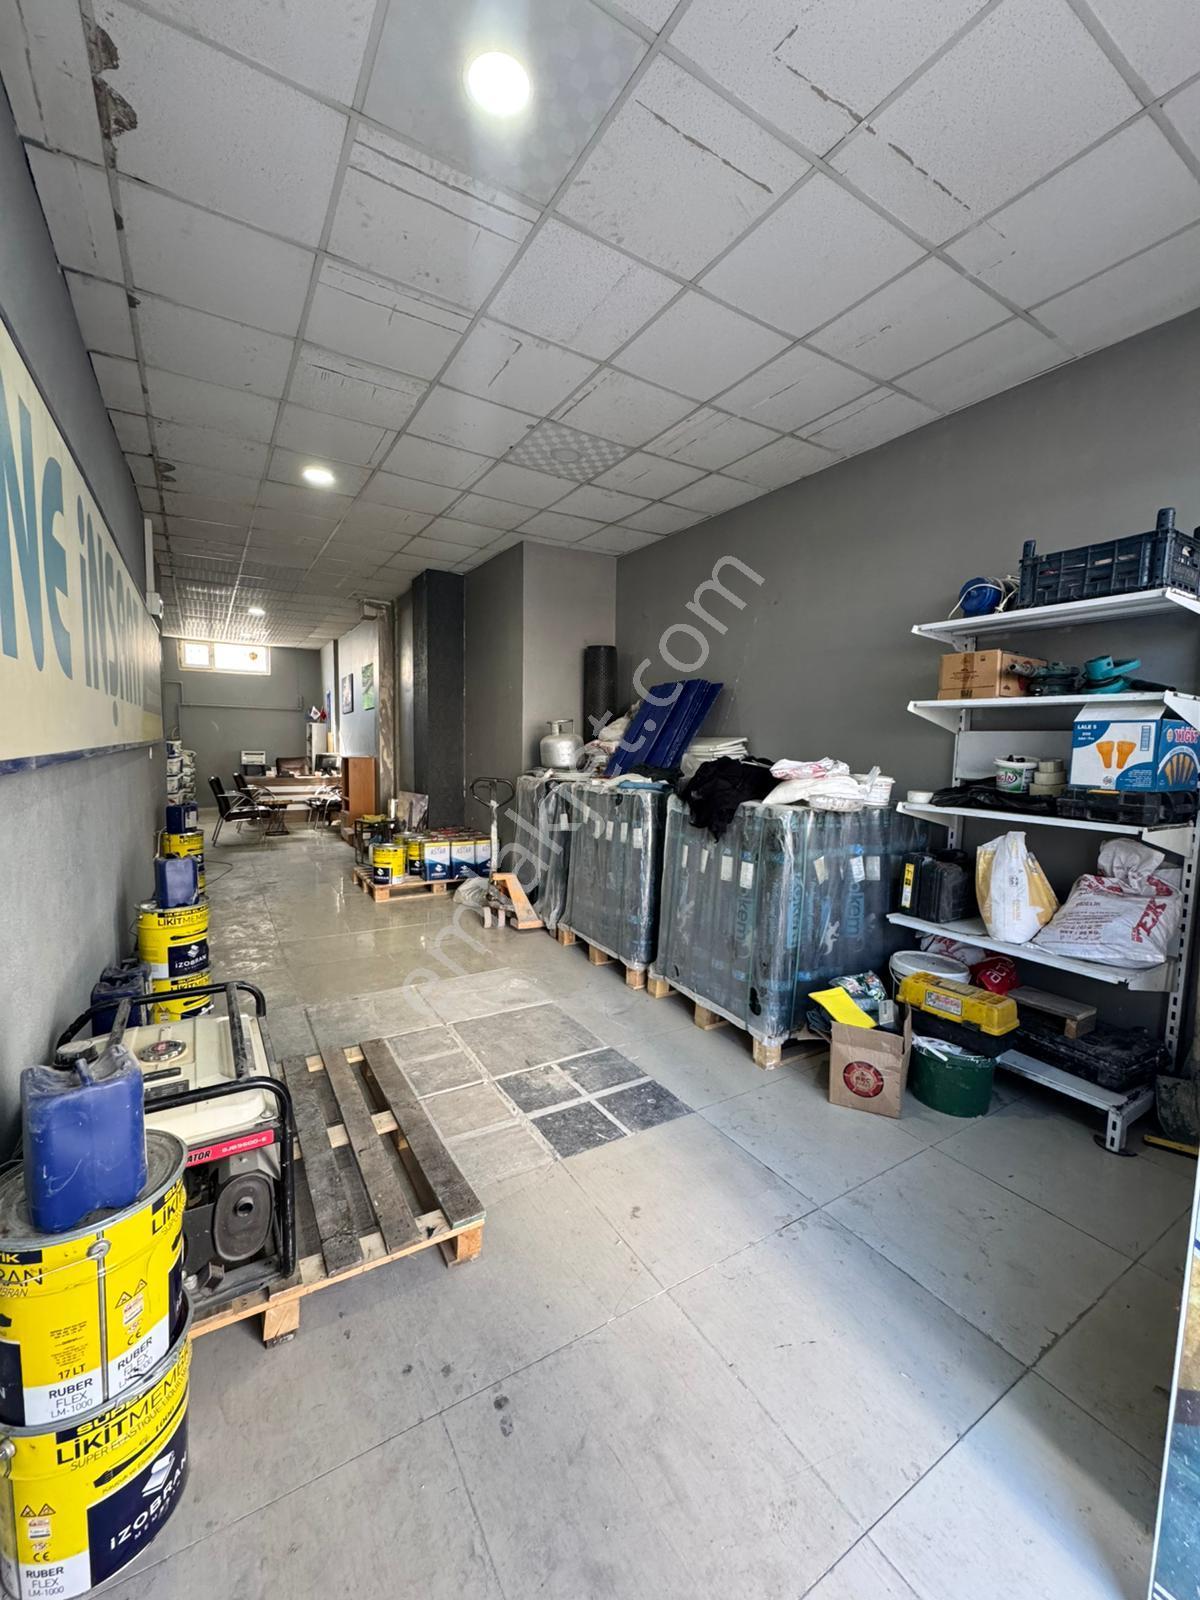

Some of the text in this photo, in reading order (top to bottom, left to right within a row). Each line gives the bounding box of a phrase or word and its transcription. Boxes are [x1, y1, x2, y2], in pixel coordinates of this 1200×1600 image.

[118, 1336, 152, 1370] RUBER
[58, 1363, 86, 1380] 17 LT
[49, 1378, 93, 1399] RUBER
[56, 1390, 88, 1409] FLEX
[26, 1566, 64, 1578] RUBER
[32, 1577, 59, 1589] FLEX
